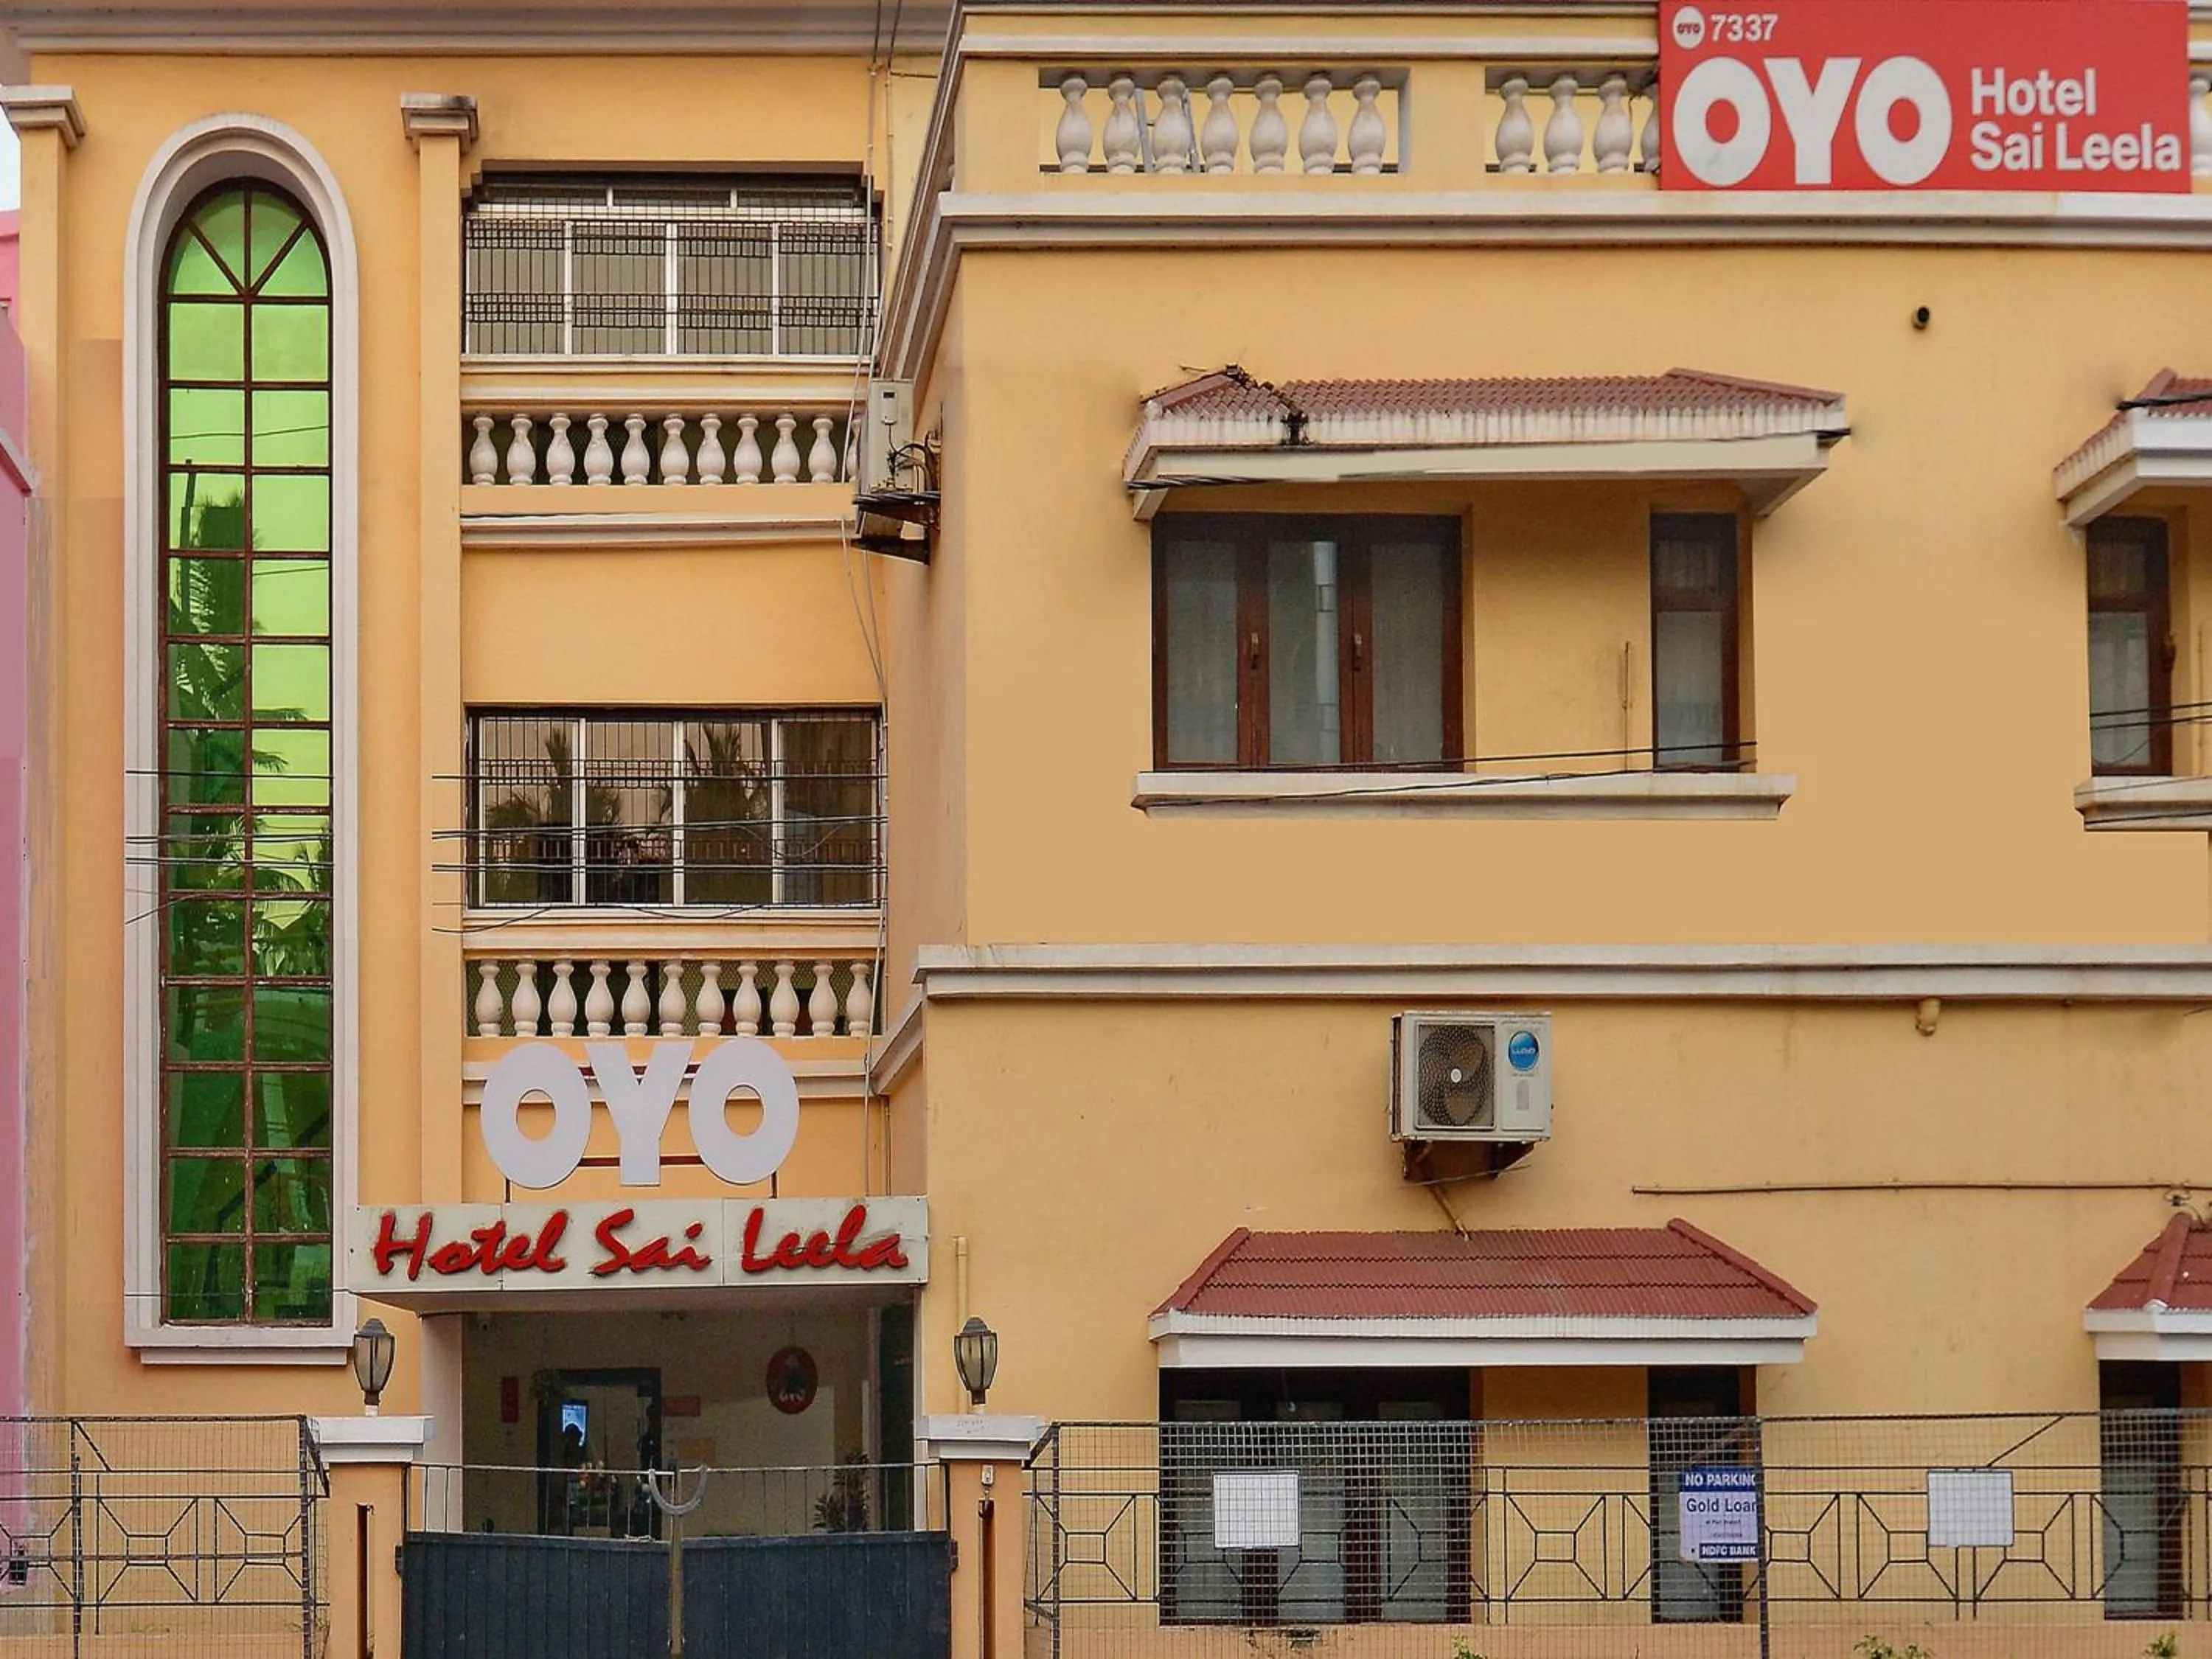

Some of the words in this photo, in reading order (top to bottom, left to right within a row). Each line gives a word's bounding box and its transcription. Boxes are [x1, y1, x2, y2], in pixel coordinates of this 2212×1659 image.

[1677, 23, 1701, 34] OYO
[1711, 13, 1778, 42] 7337
[1972, 67, 2096, 116] Hotel
[1672, 55, 1952, 187] OYO
[1970, 121, 2043, 171] Sai
[2056, 122, 2181, 171] Leela
[481, 1037, 800, 1189] OYO
[373, 1211, 568, 1279] Hotel
[594, 1208, 712, 1277] Sai
[741, 1203, 908, 1273] Leela
[1685, 1473, 1703, 1486] NO
[1686, 1498, 1719, 1512] Gold
